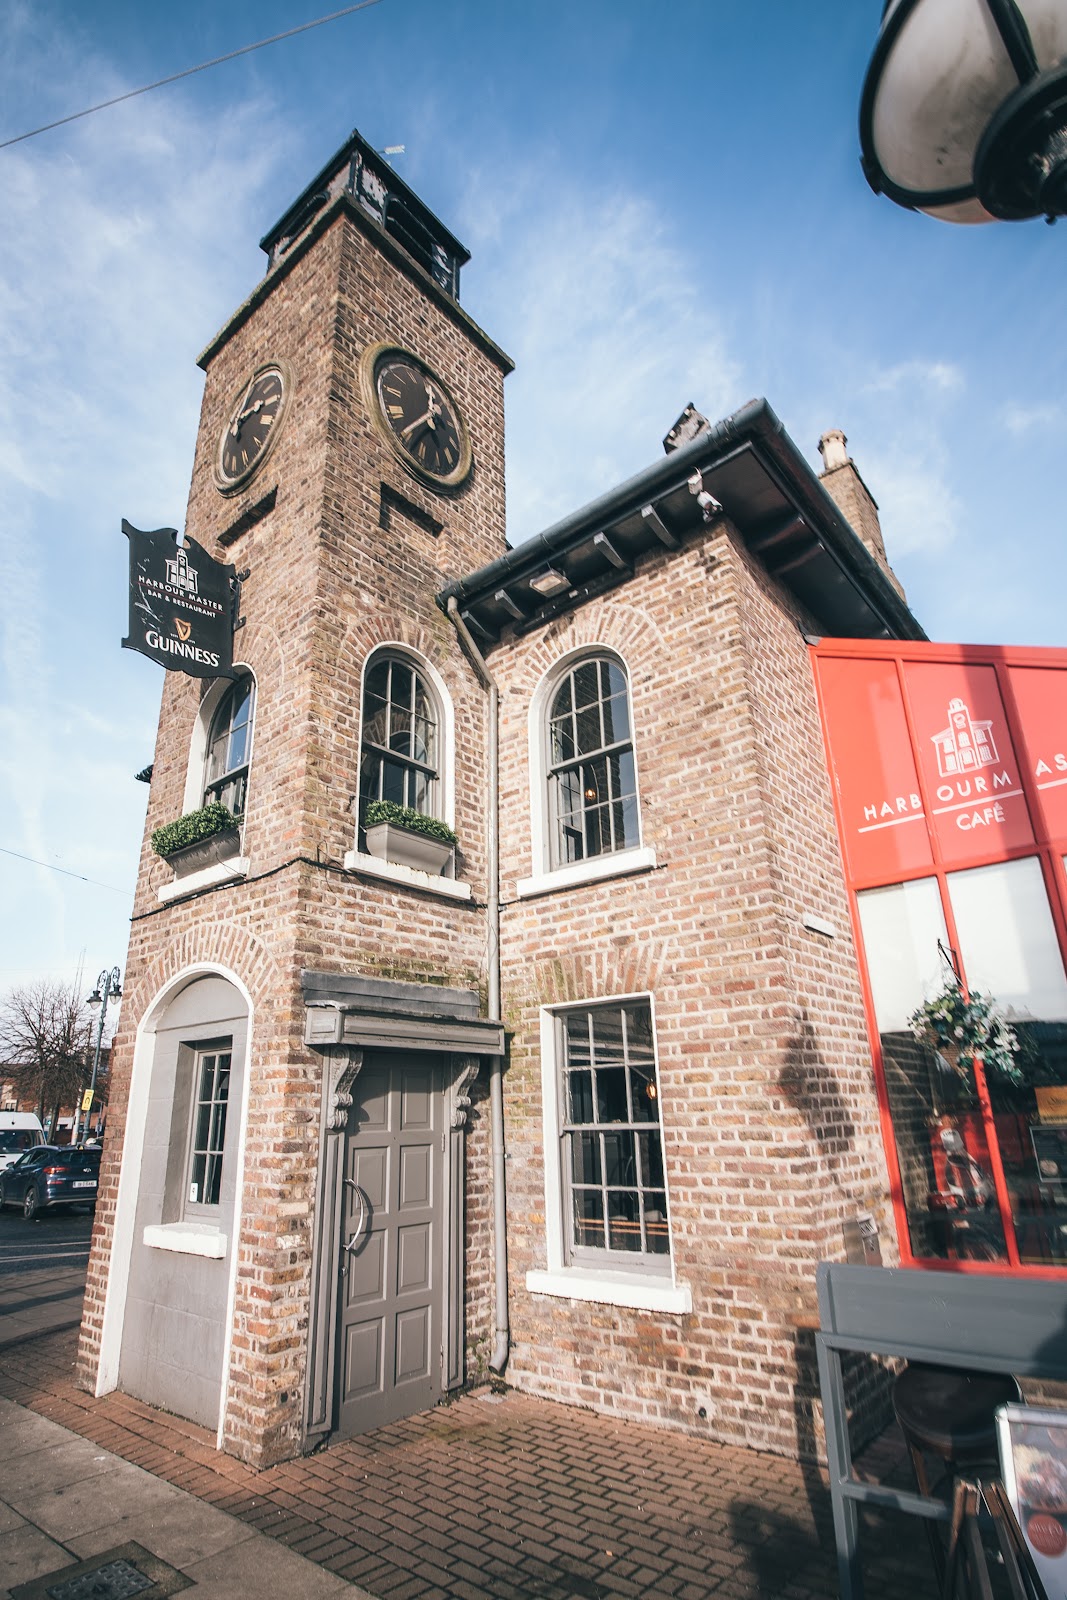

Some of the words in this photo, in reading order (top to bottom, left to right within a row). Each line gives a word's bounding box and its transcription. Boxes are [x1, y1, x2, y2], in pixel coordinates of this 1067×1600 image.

[138, 575, 185, 597] HARBOUR
[188, 593, 223, 611] MASTER
[147, 589, 162, 599] BAR
[173, 597, 216, 618] RESTAURANT
[145, 630, 219, 667] GUINNESS
[956, 801, 1005, 831] CAFÉ
